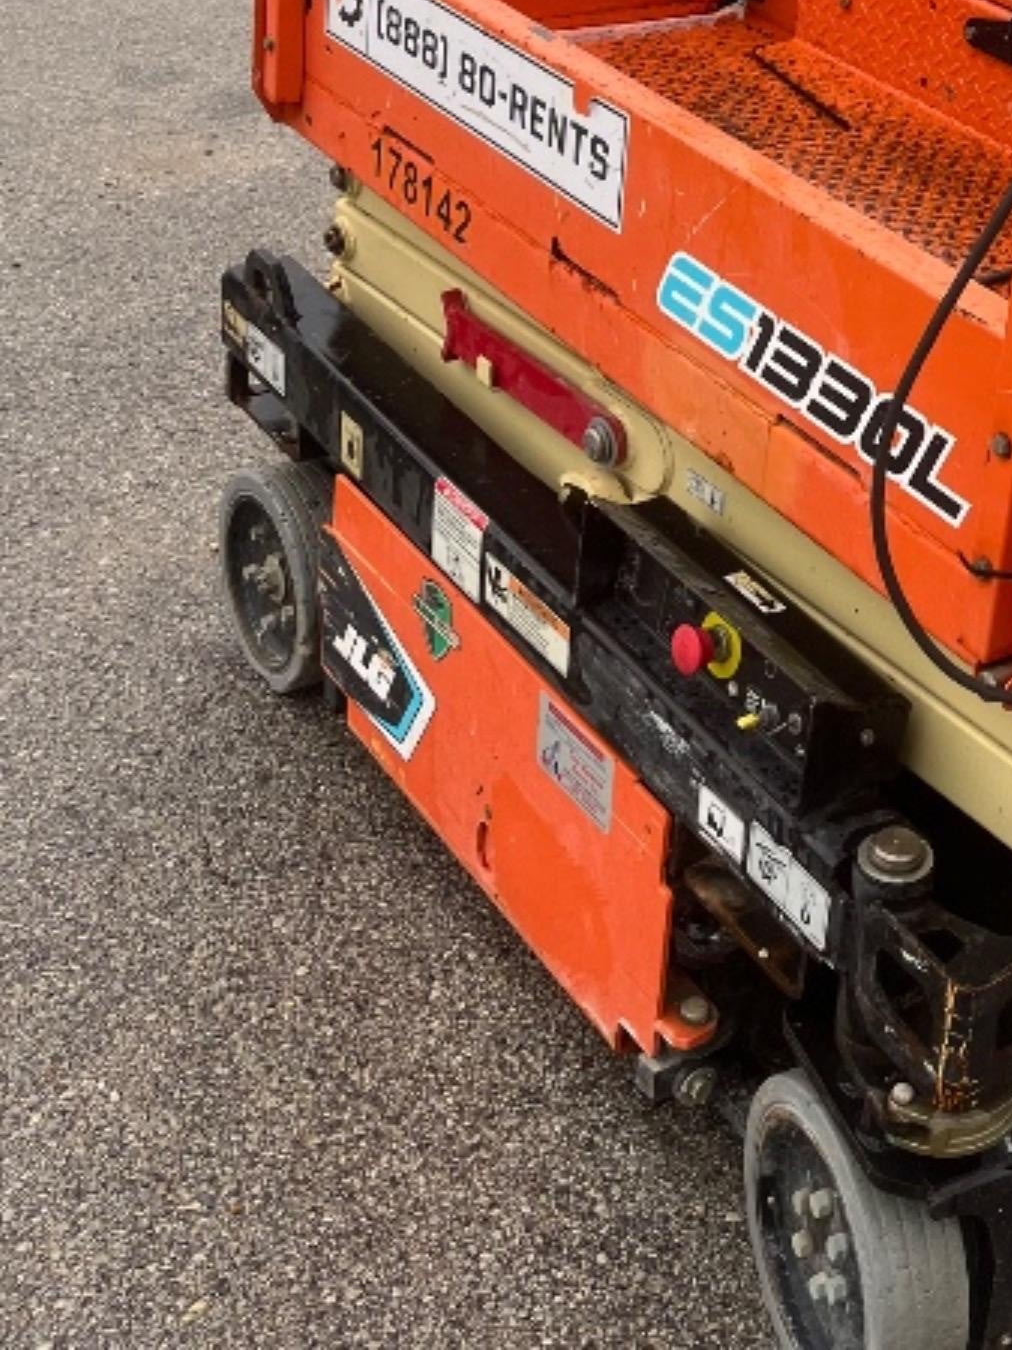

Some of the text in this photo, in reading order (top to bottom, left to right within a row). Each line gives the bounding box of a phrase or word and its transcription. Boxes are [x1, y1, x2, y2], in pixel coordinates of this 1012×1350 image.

[458, 52, 610, 181] 80-RENTS
[371, 137, 472, 243] 178142
[657, 252, 970, 526] ES1330L
[332, 623, 397, 701] JLG
